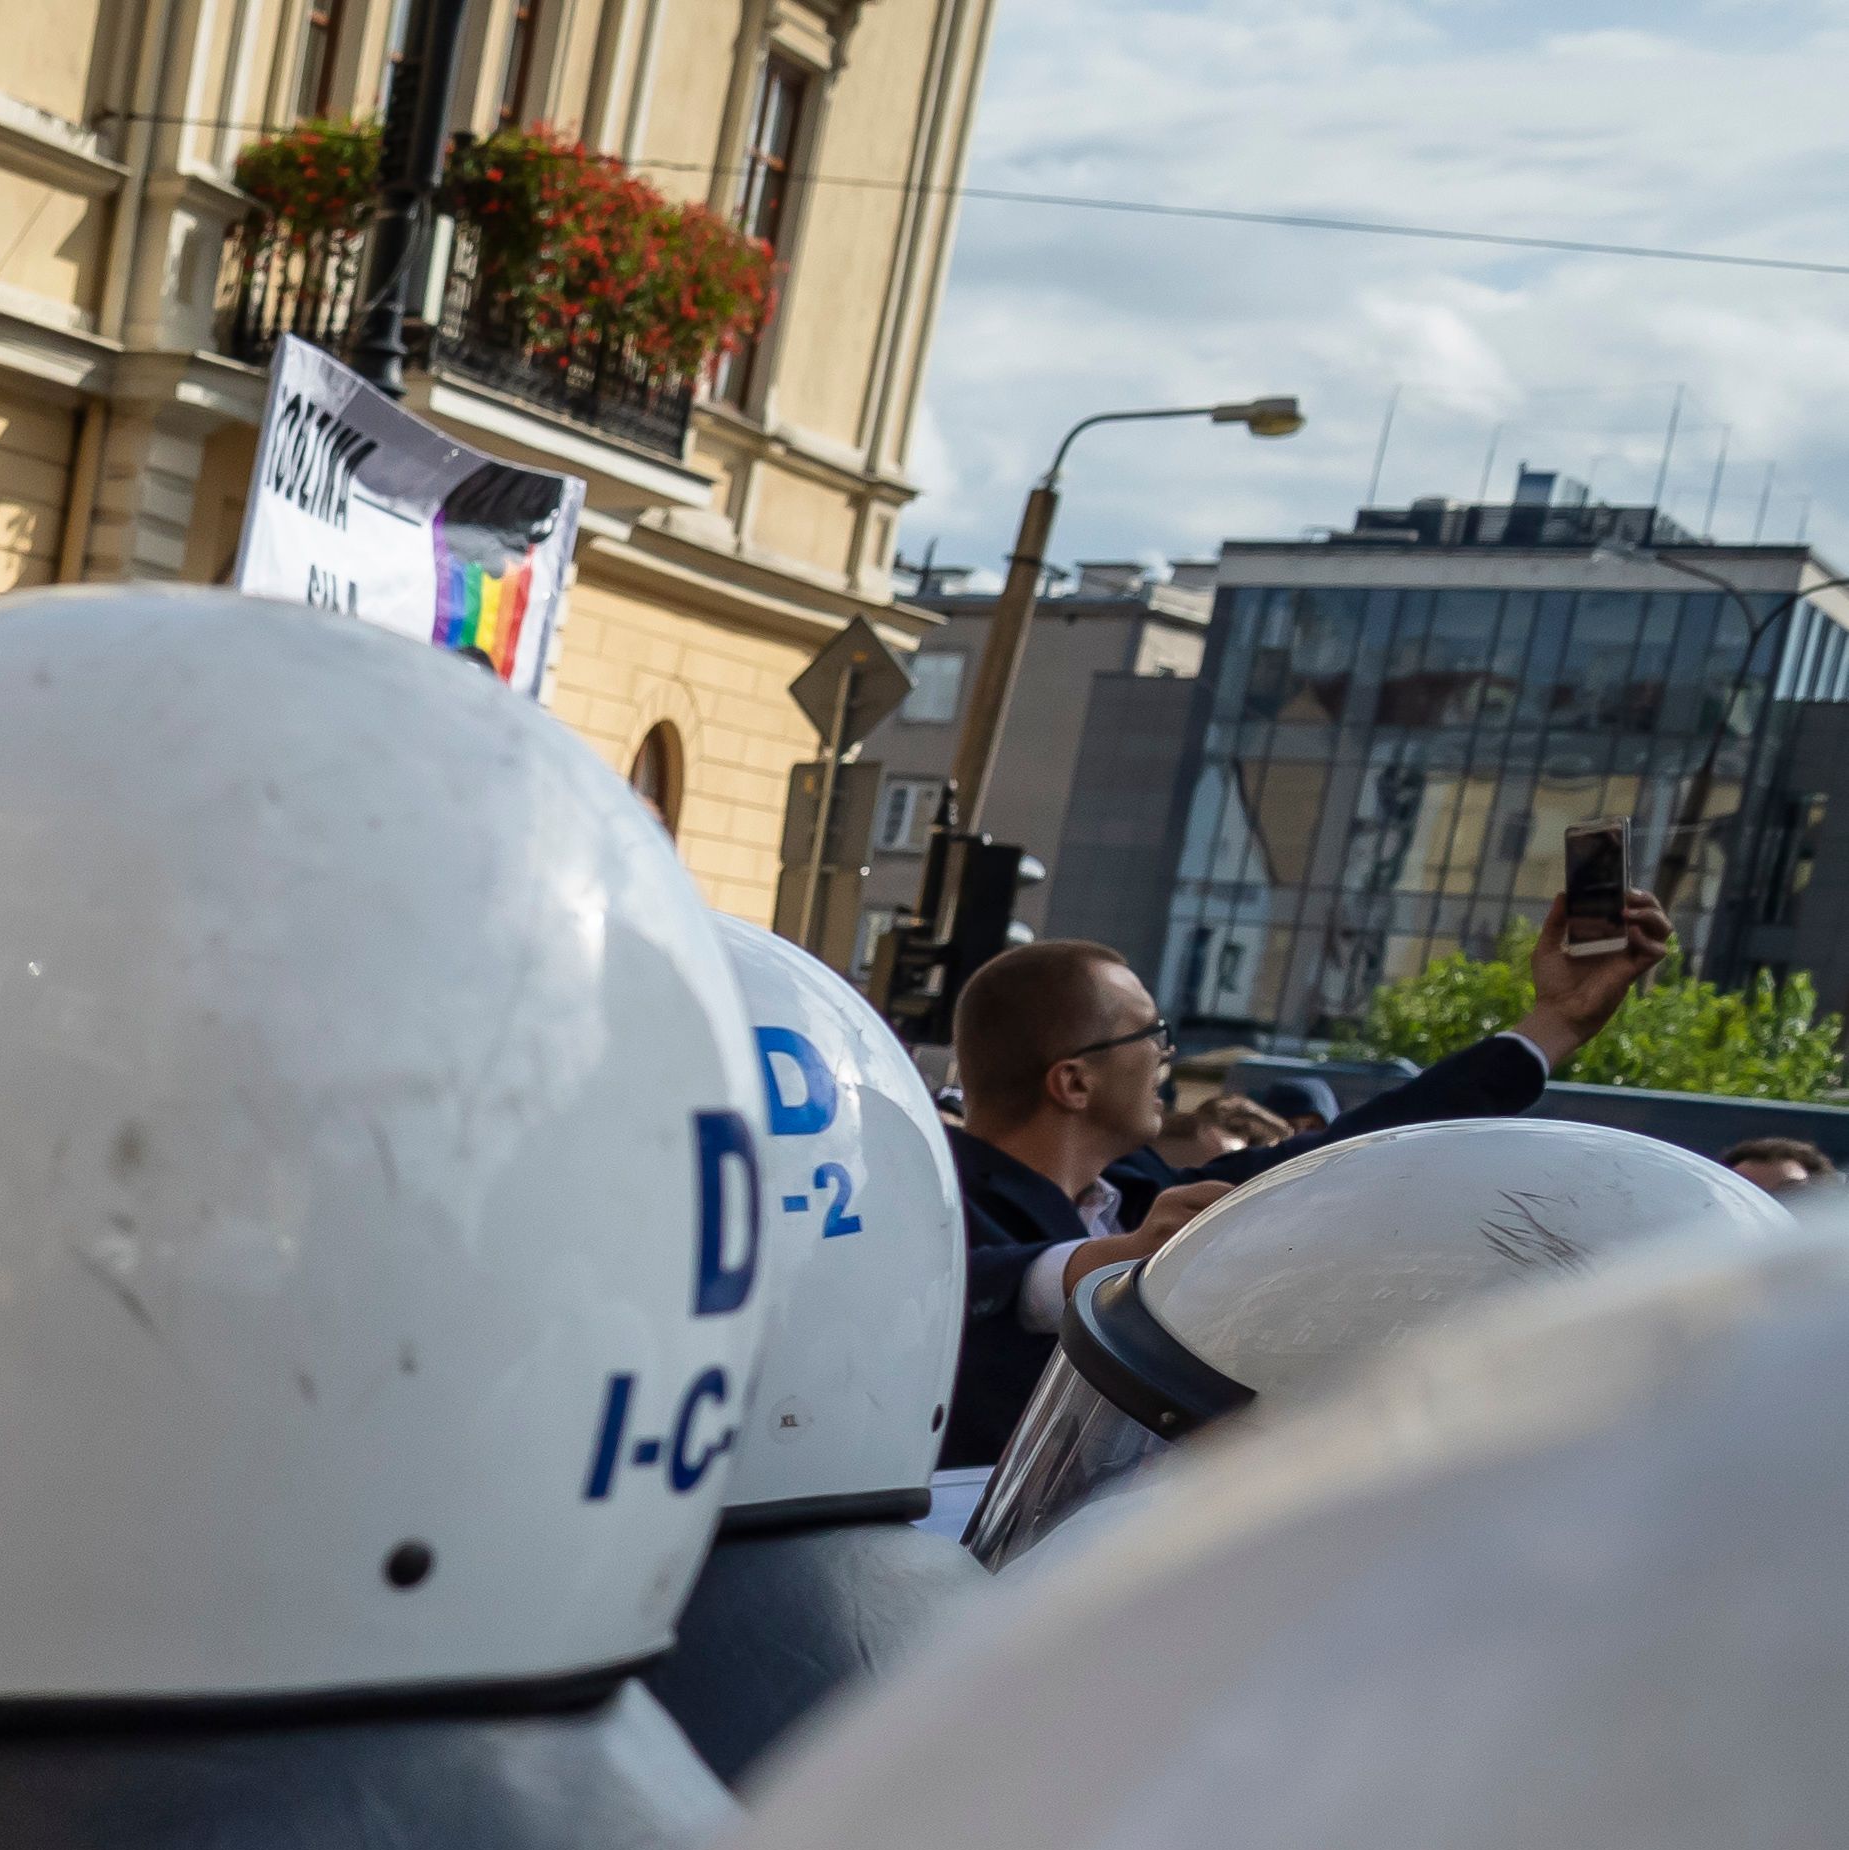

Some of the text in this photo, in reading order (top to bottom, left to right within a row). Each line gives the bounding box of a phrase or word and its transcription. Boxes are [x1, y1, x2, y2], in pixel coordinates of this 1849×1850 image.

[753, 1025, 838, 1135] D
[691, 1108, 762, 1318] D
[781, 1162, 863, 1239] -2
